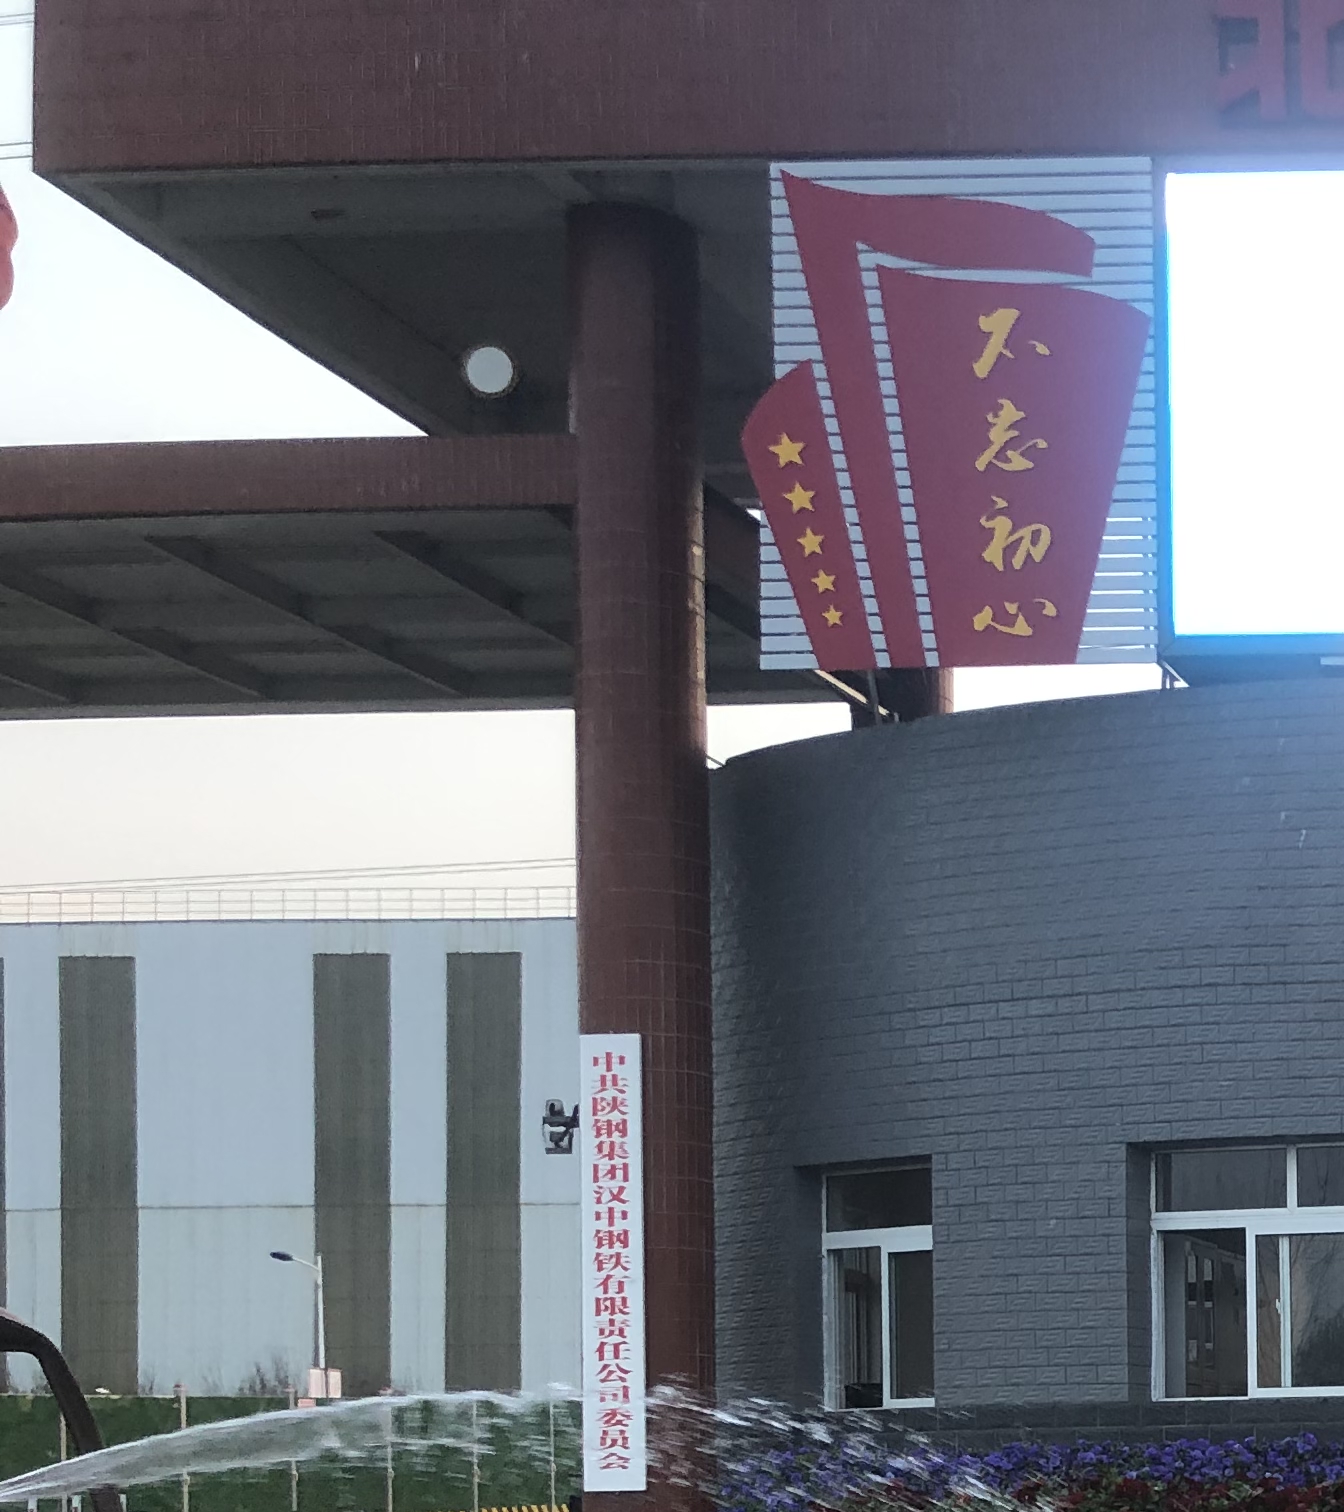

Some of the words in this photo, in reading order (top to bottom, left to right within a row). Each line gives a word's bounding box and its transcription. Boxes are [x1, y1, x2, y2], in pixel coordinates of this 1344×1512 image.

[972, 308, 1058, 637] 不忘初心
[591, 1051, 633, 1471] 中共陕钢集团汉中钢铁有限责任公司委员会
